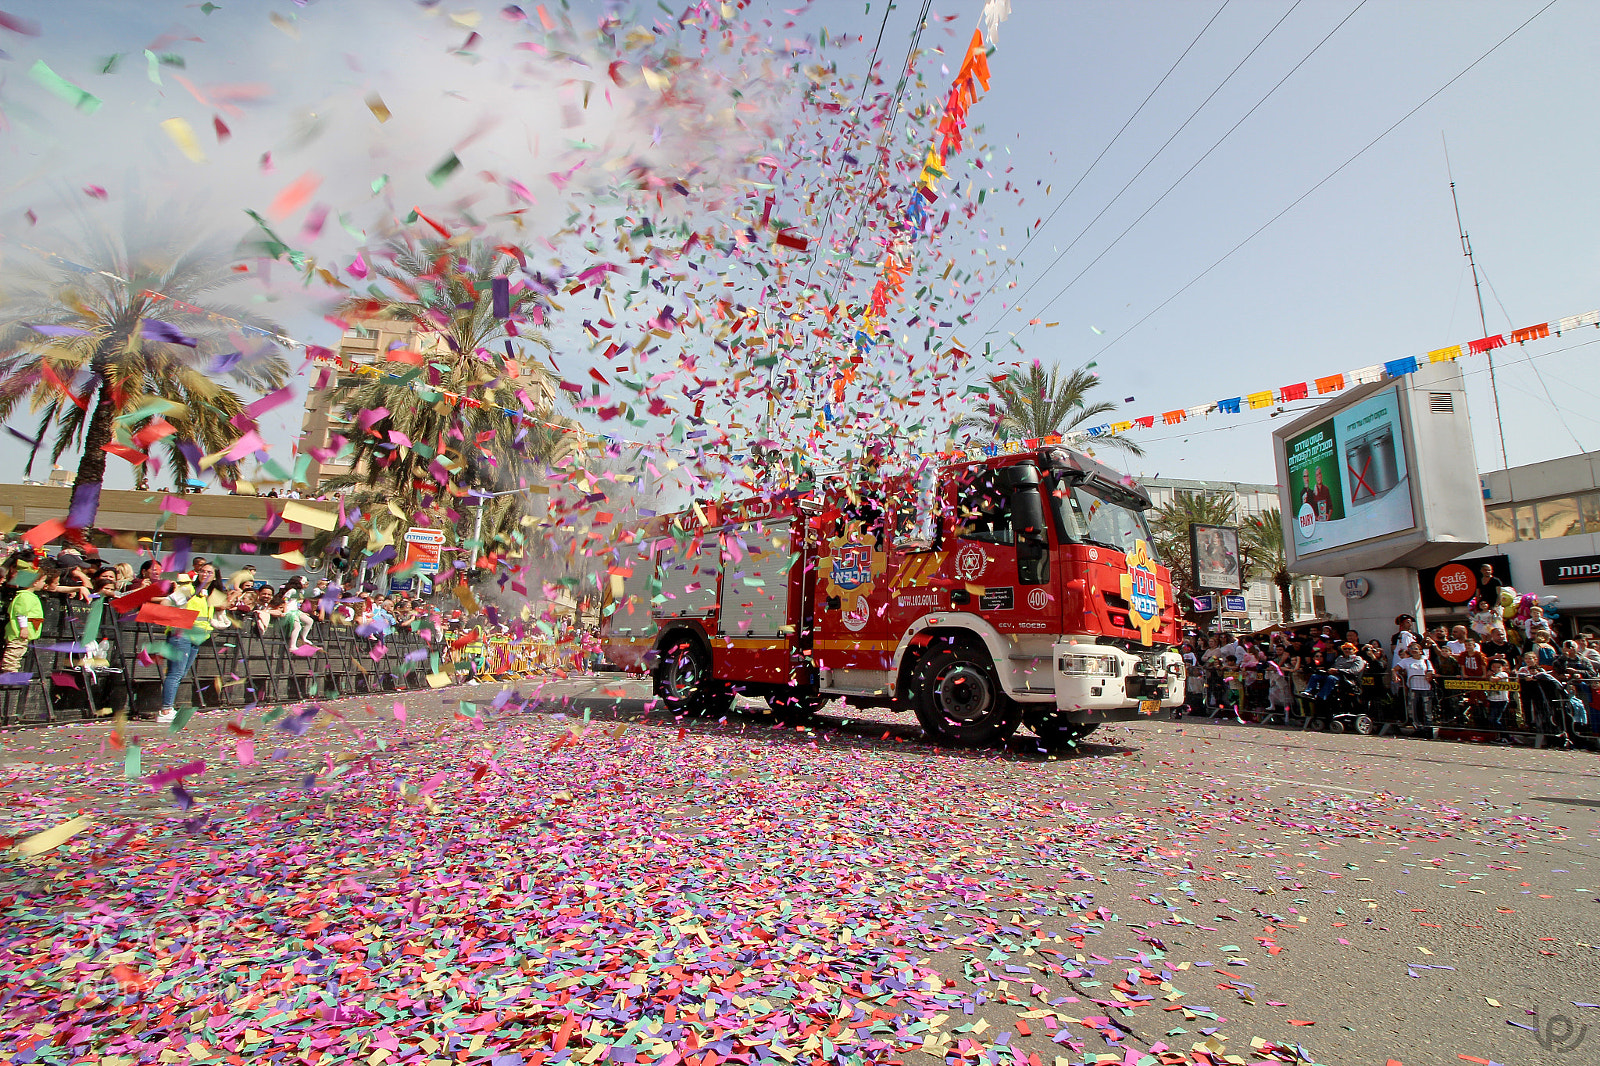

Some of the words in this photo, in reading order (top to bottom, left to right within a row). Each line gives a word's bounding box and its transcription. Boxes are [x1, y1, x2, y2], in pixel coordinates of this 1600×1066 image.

[1299, 512, 1314, 528] FAIRY
[1128, 564, 1157, 598] סמי
[1440, 571, 1467, 584] café
[1030, 592, 1046, 606] 400
[1130, 594, 1158, 616] הכבאי
